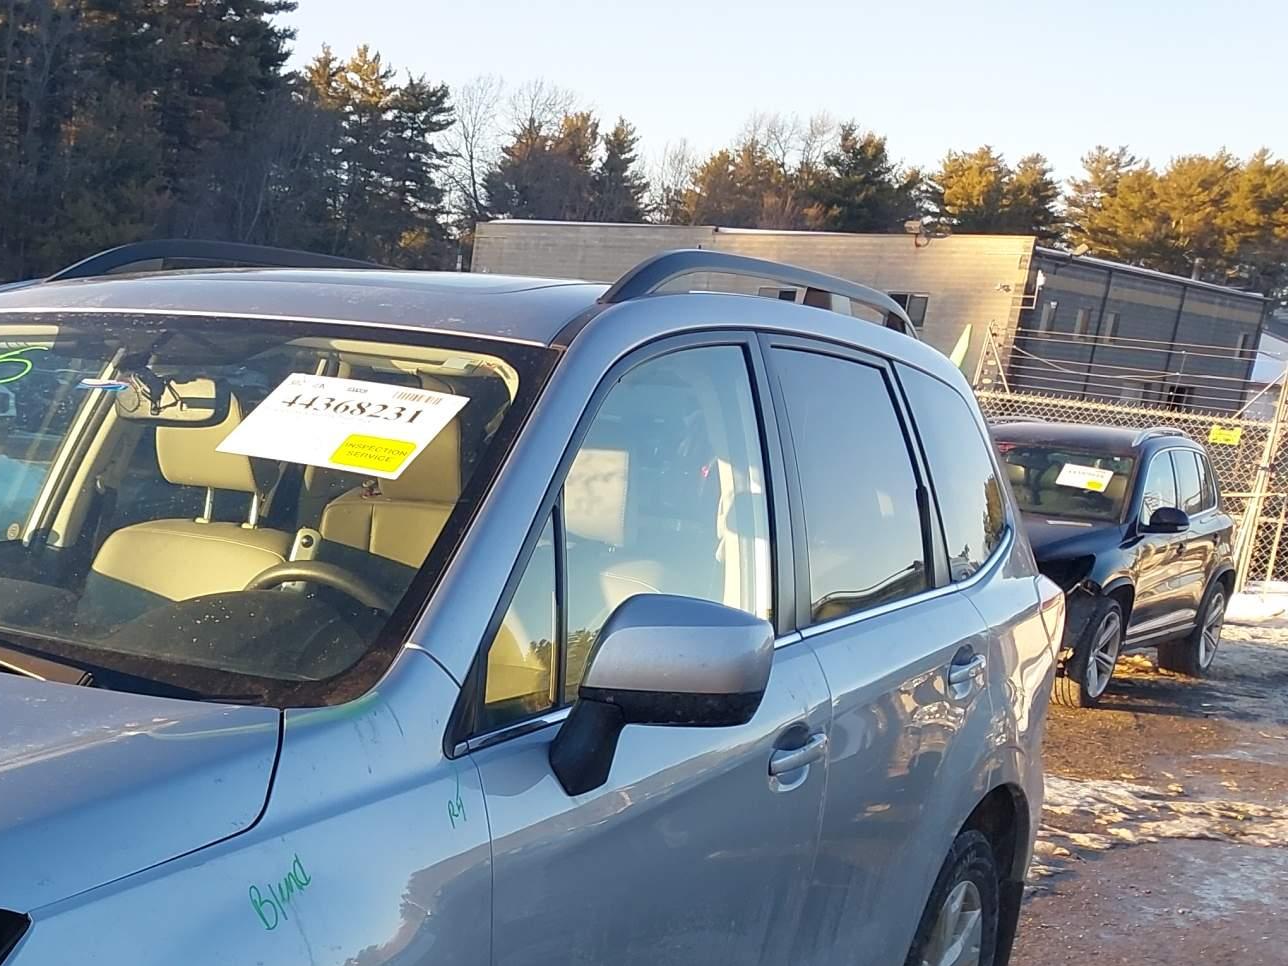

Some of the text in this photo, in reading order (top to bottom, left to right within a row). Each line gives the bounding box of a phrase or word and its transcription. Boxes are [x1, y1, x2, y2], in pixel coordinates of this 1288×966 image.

[281, 393, 425, 424] 44368231
[345, 441, 408, 457] INSPECTION
[345, 450, 392, 463] SERVICE
[249, 852, 312, 931] Blend
